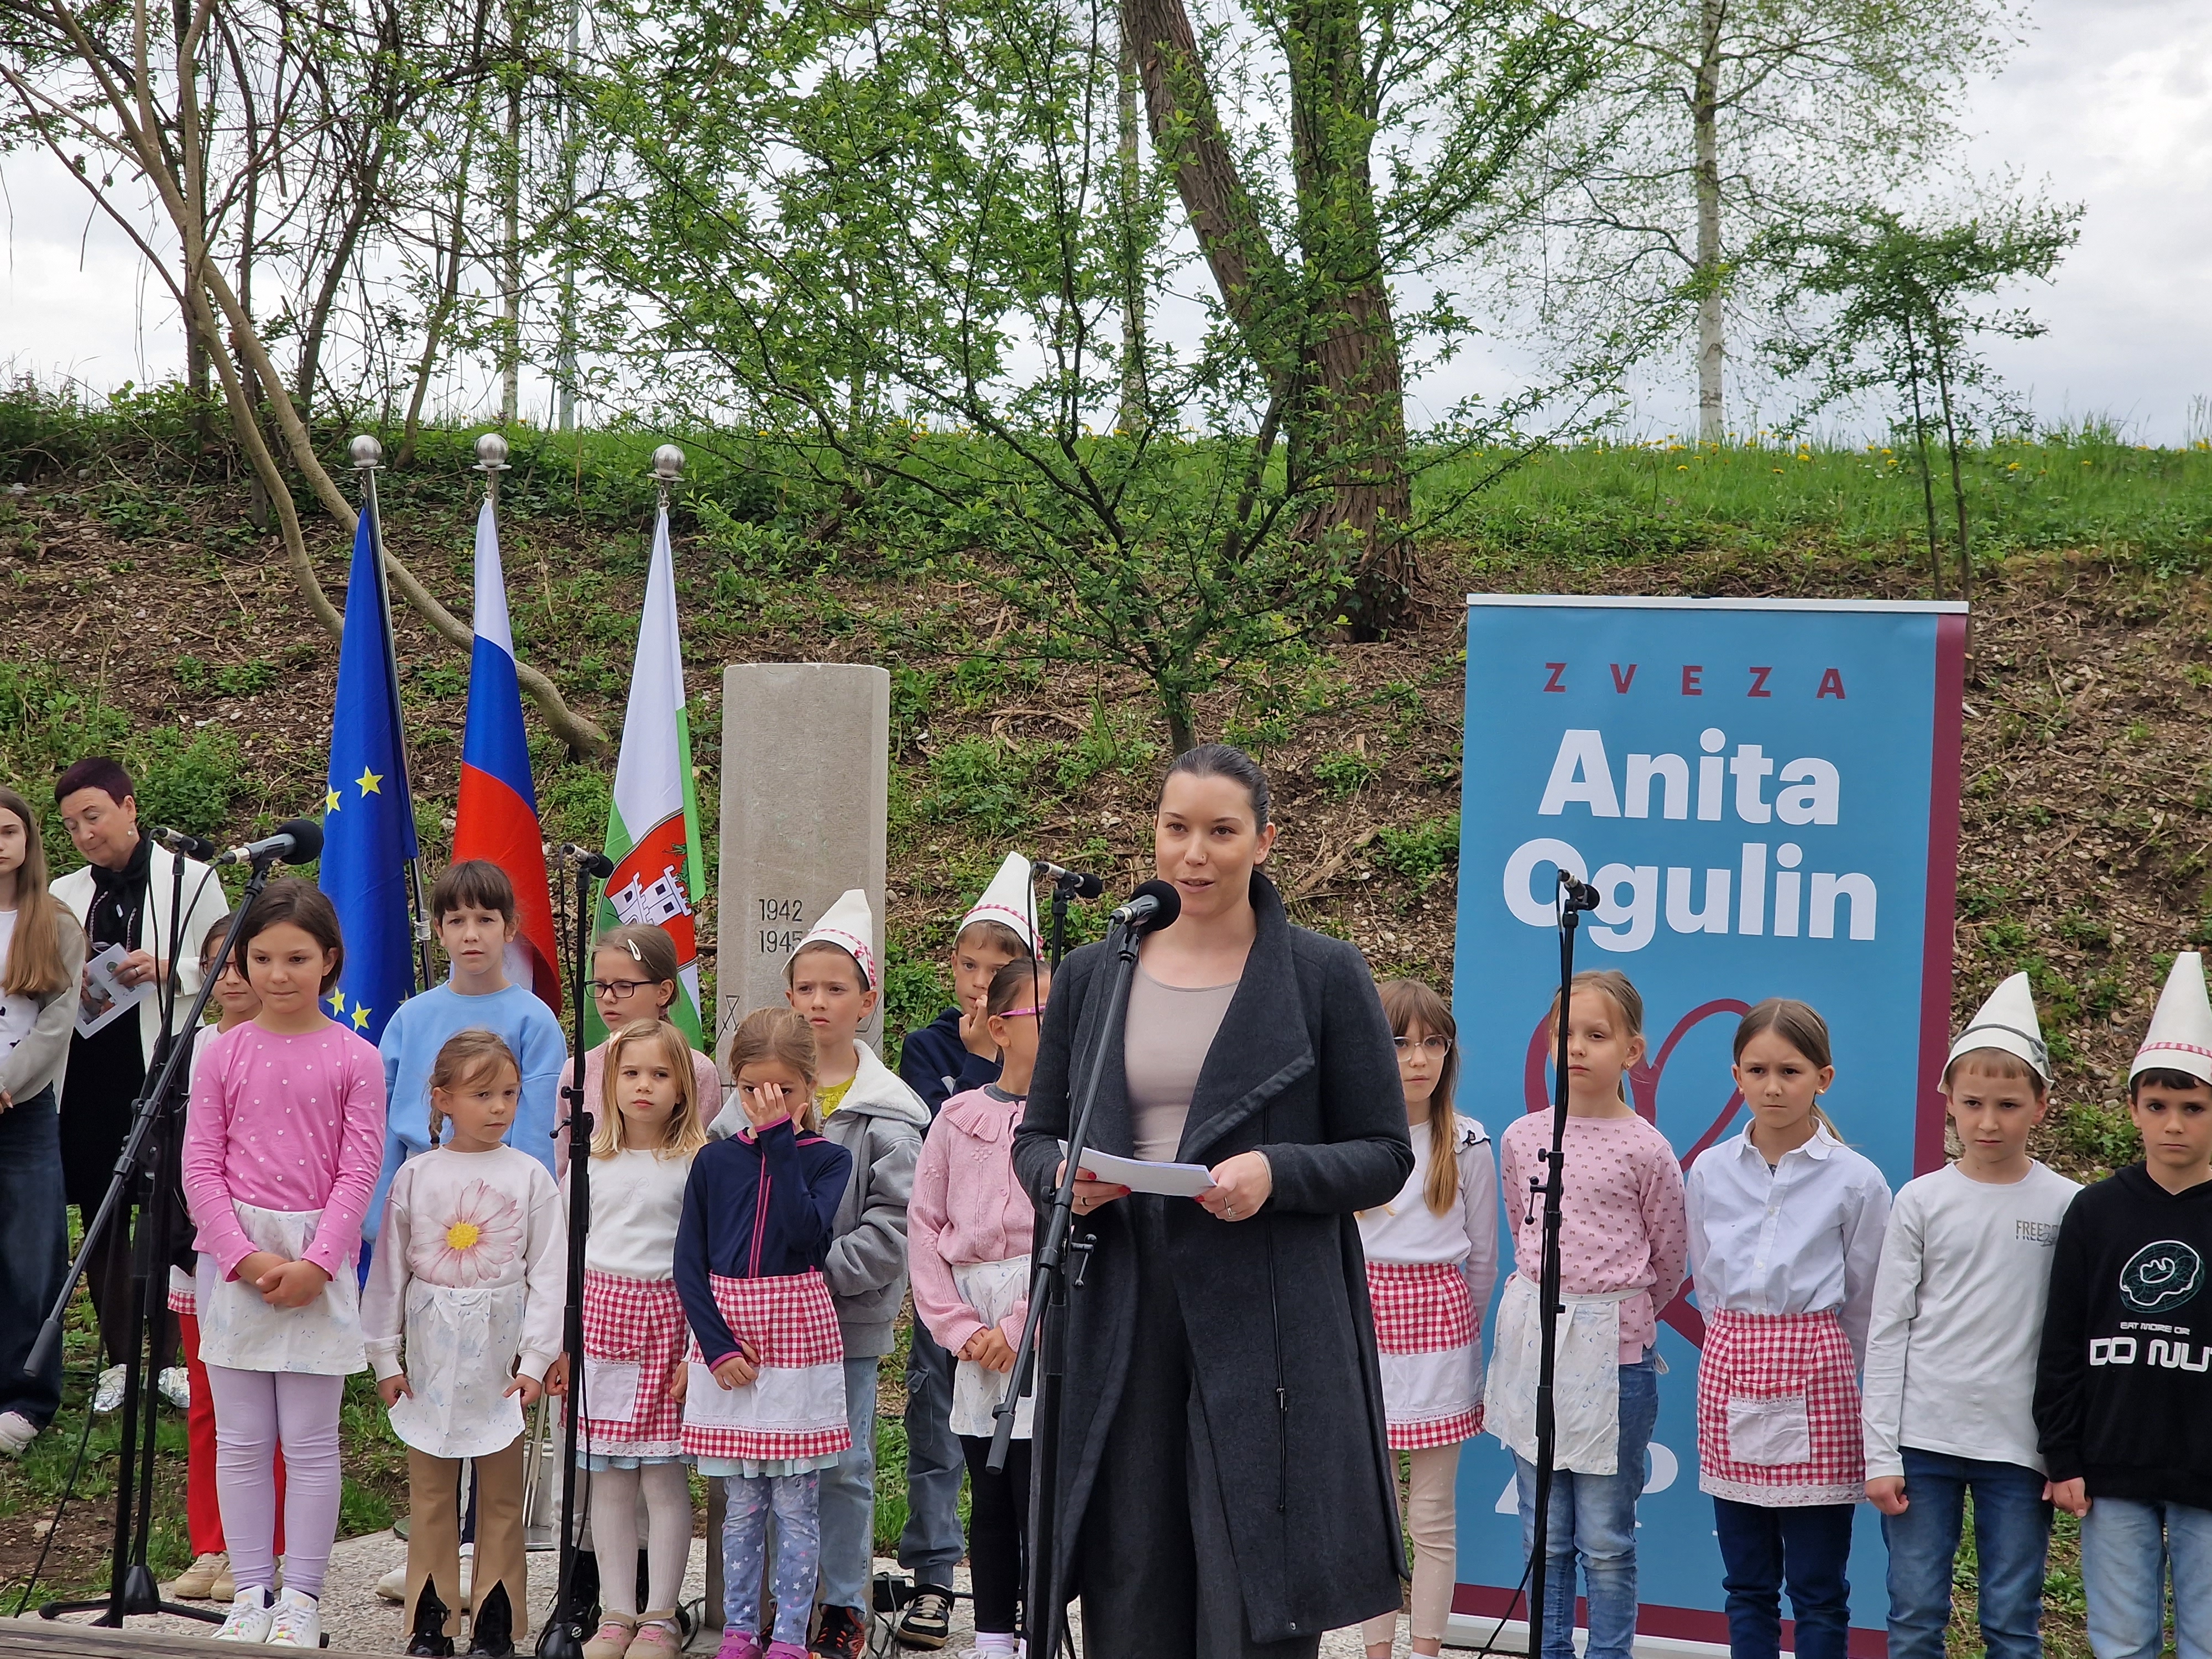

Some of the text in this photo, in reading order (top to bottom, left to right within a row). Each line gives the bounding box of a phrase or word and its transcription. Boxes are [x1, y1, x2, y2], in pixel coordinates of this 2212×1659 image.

[1543, 662, 1846, 699] ZVEZA
[1537, 728, 1840, 825] Anita
[759, 899, 802, 921] 1942
[1503, 838, 1877, 952] Ogulin
[759, 930, 803, 953] 1945
[2140, 1323, 2172, 1333] MORE
[2174, 1326, 2190, 1335] OR
[2090, 1337, 2212, 1372] DO NU
